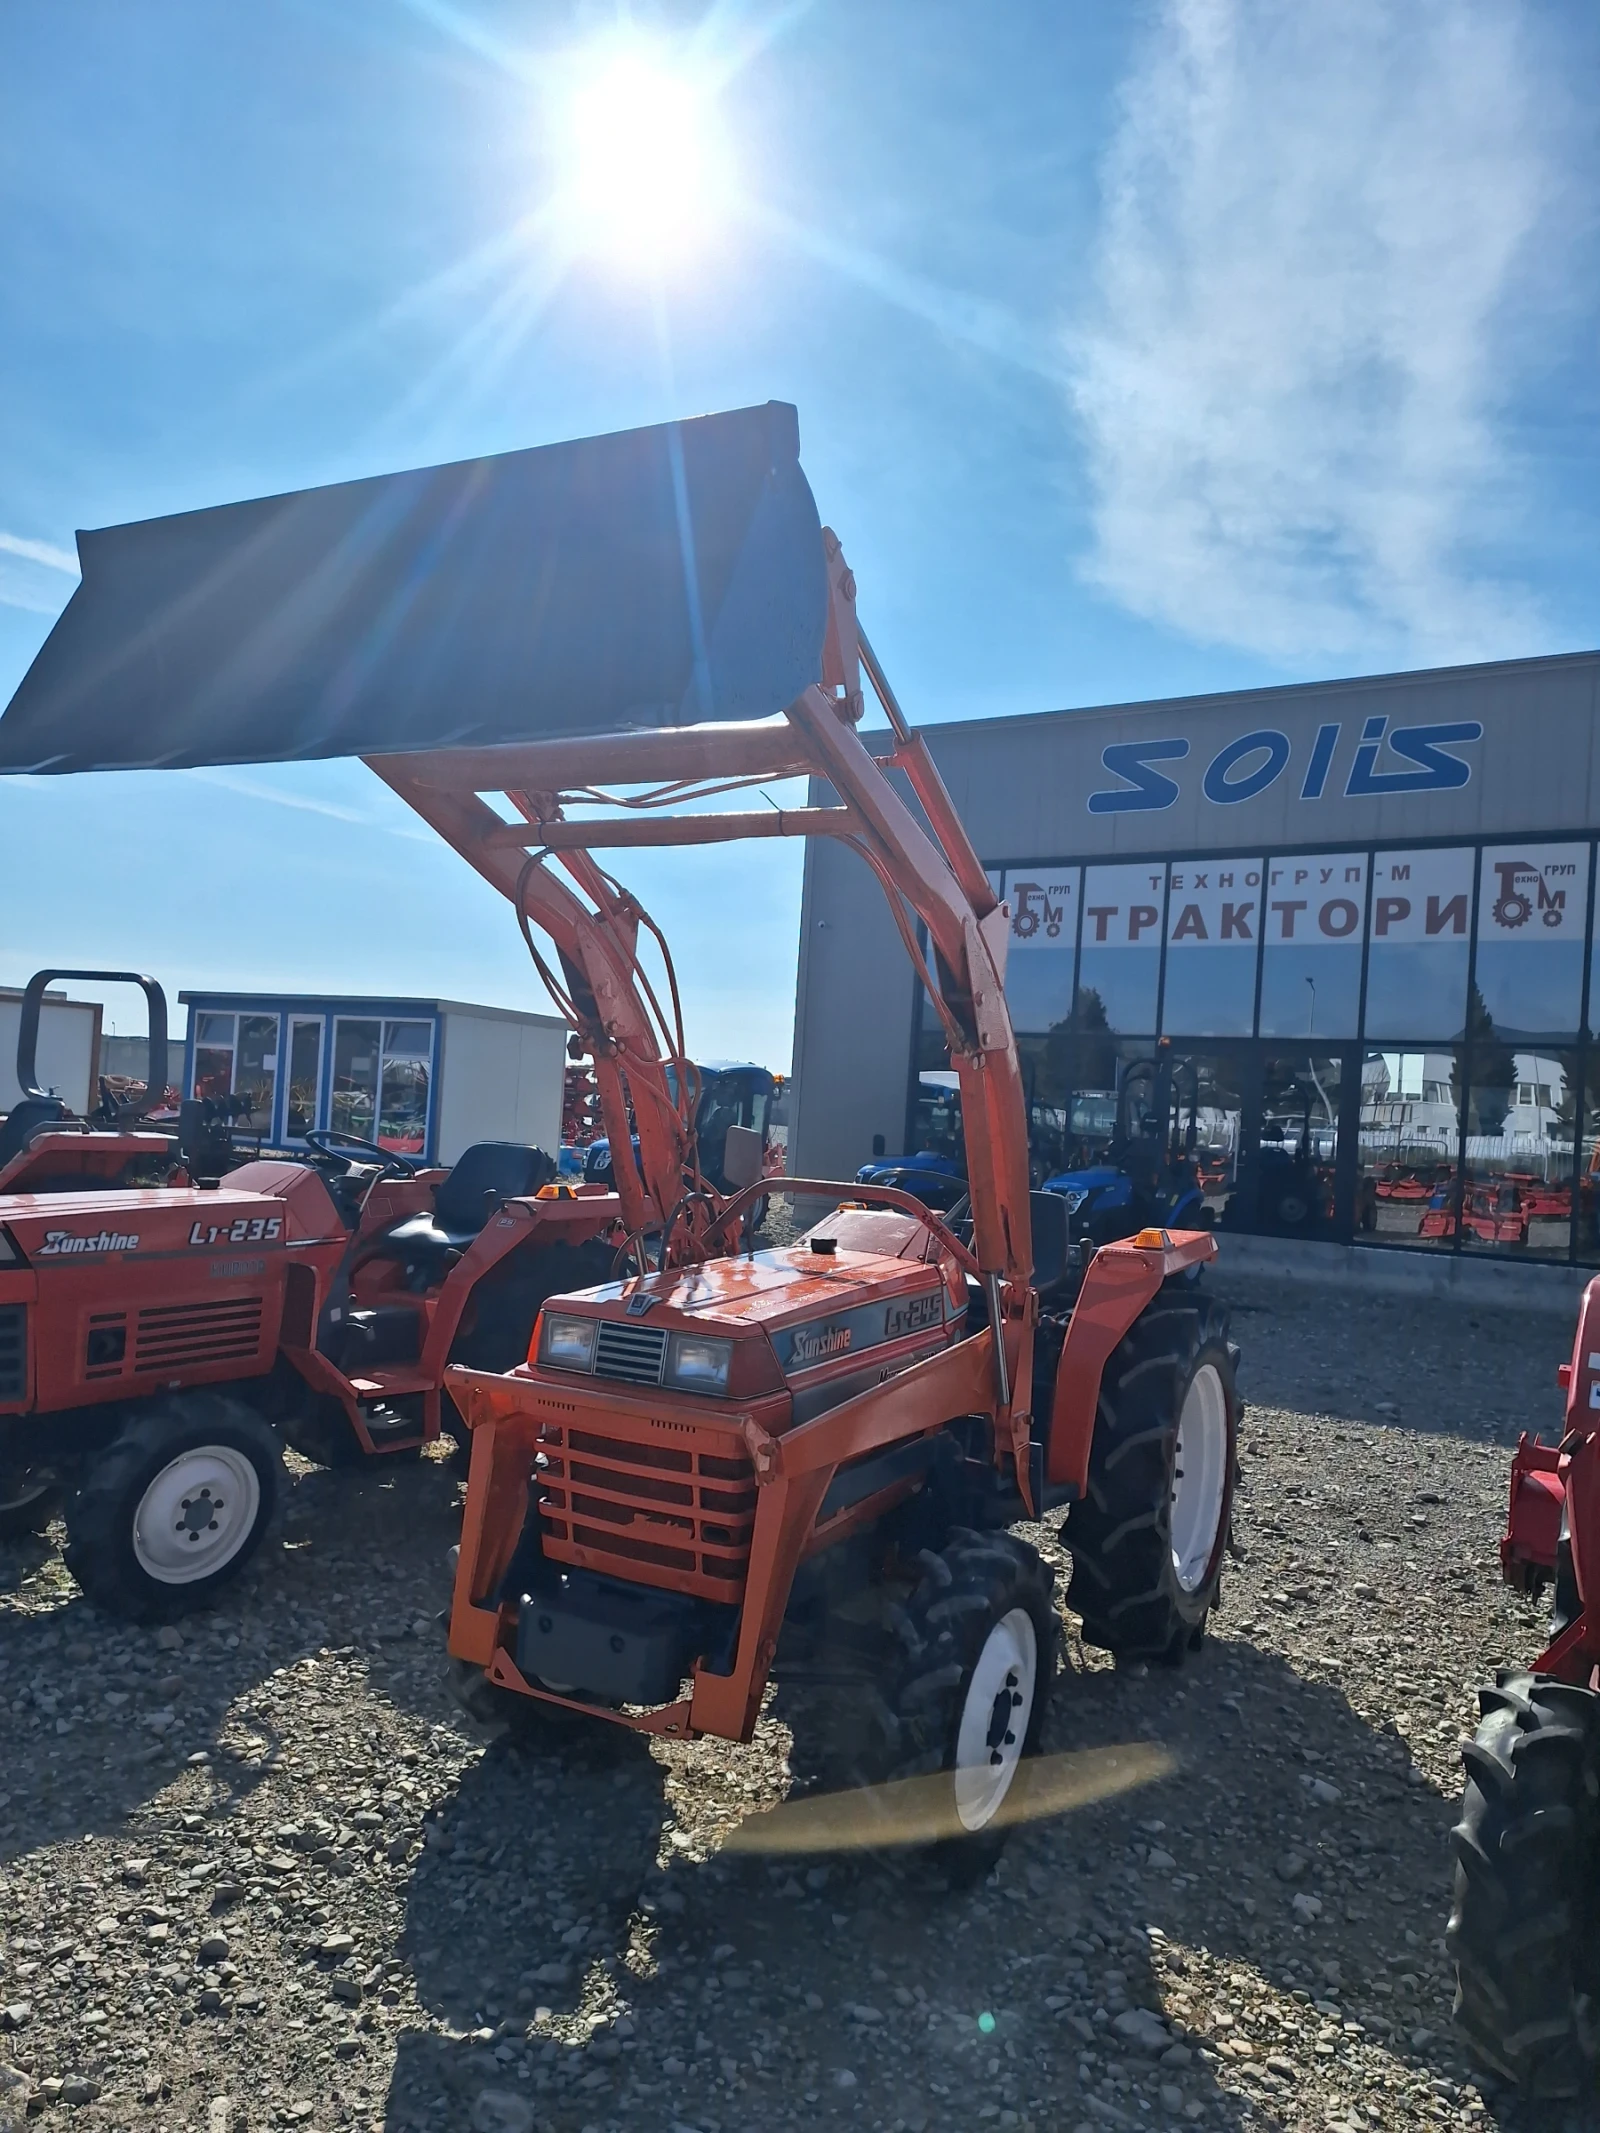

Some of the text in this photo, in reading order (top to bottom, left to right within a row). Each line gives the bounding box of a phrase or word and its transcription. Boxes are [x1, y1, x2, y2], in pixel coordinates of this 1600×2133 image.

[1545, 864, 1576, 876] ГРУП
[1048, 885, 1071, 896] ГРУП
[1087, 894, 1468, 941] ТРАКТОРИ
[35, 1217, 283, 1255] Sunshine L1-235
[788, 1326, 852, 1363] Sunshine
